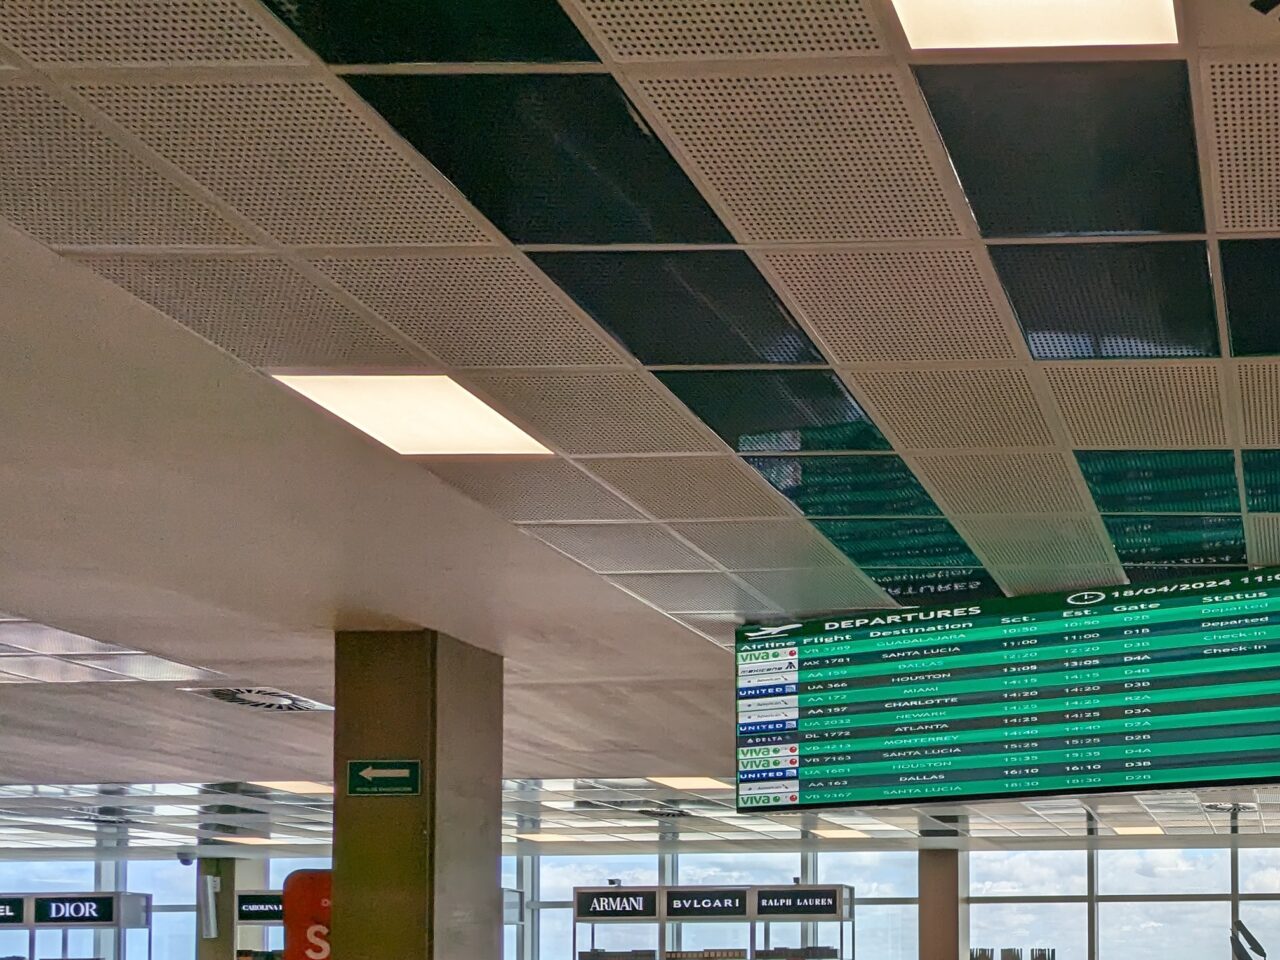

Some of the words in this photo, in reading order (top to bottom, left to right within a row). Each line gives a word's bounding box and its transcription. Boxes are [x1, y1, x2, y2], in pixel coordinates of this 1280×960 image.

[824, 606, 981, 630] DEPARTURES
[1111, 579, 1231, 598] 18/04/2024
[740, 640, 796, 650] Airline
[802, 634, 851, 644] Flight
[869, 621, 973, 636] Destination
[1000, 615, 1036, 623] Sct.
[1061, 609, 1098, 617] Est.
[1112, 602, 1160, 612] Gate
[1201, 590, 1268, 602] Status
[881, 650, 920, 658] SANTA
[923, 646, 960, 655] LUCIA
[1200, 615, 1269, 629] Departed
[738, 687, 782, 696] UNITED
[891, 672, 951, 682] HOUSTON
[884, 697, 957, 708] CHARLOTTE
[739, 723, 782, 731] UNITED
[894, 723, 949, 732] ATLANTA
[739, 771, 783, 779] UNITED
[589, 896, 644, 912] ARMANI
[672, 898, 740, 909] BVLGARI
[761, 898, 792, 907] RALPH
[797, 897, 833, 907] LAUREN
[50, 901, 98, 918] DIOR
[242, 904, 277, 912] CAROLINA
